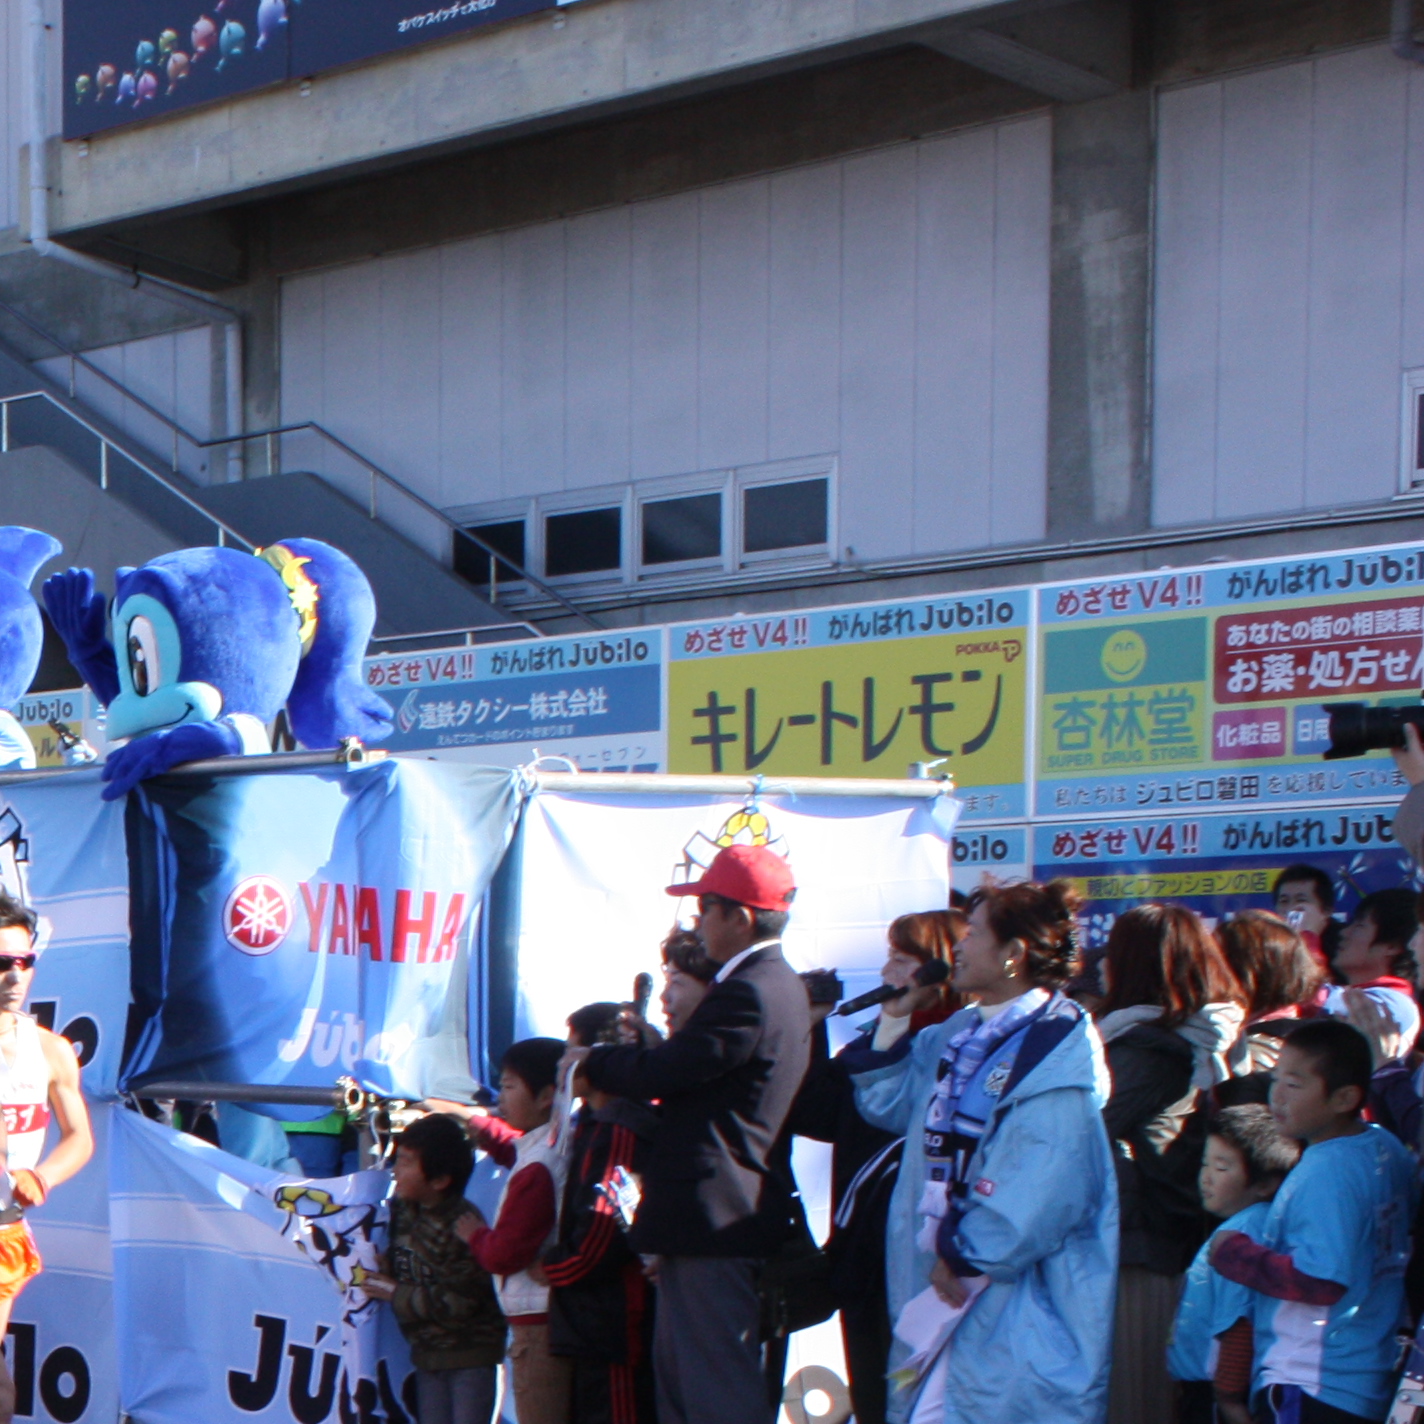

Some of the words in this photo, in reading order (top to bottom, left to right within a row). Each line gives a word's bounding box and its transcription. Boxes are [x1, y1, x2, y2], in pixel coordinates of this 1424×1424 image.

[956, 641, 1001, 656] POKKA
[418, 686, 609, 731] 遠鉄タクシー株式会社
[690, 669, 1003, 774] キレートレモン
[1052, 687, 1195, 751] 杏林堂
[1216, 721, 1282, 748] 化粧品
[1047, 754, 1093, 767] SUPER
[1102, 750, 1143, 764] DRUG
[1149, 745, 1199, 761] STORE
[1055, 784, 1126, 808] 私たちは
[1135, 774, 1260, 806] ジュビロ磐田
[1086, 872, 1268, 898] 親切とファッションの店
